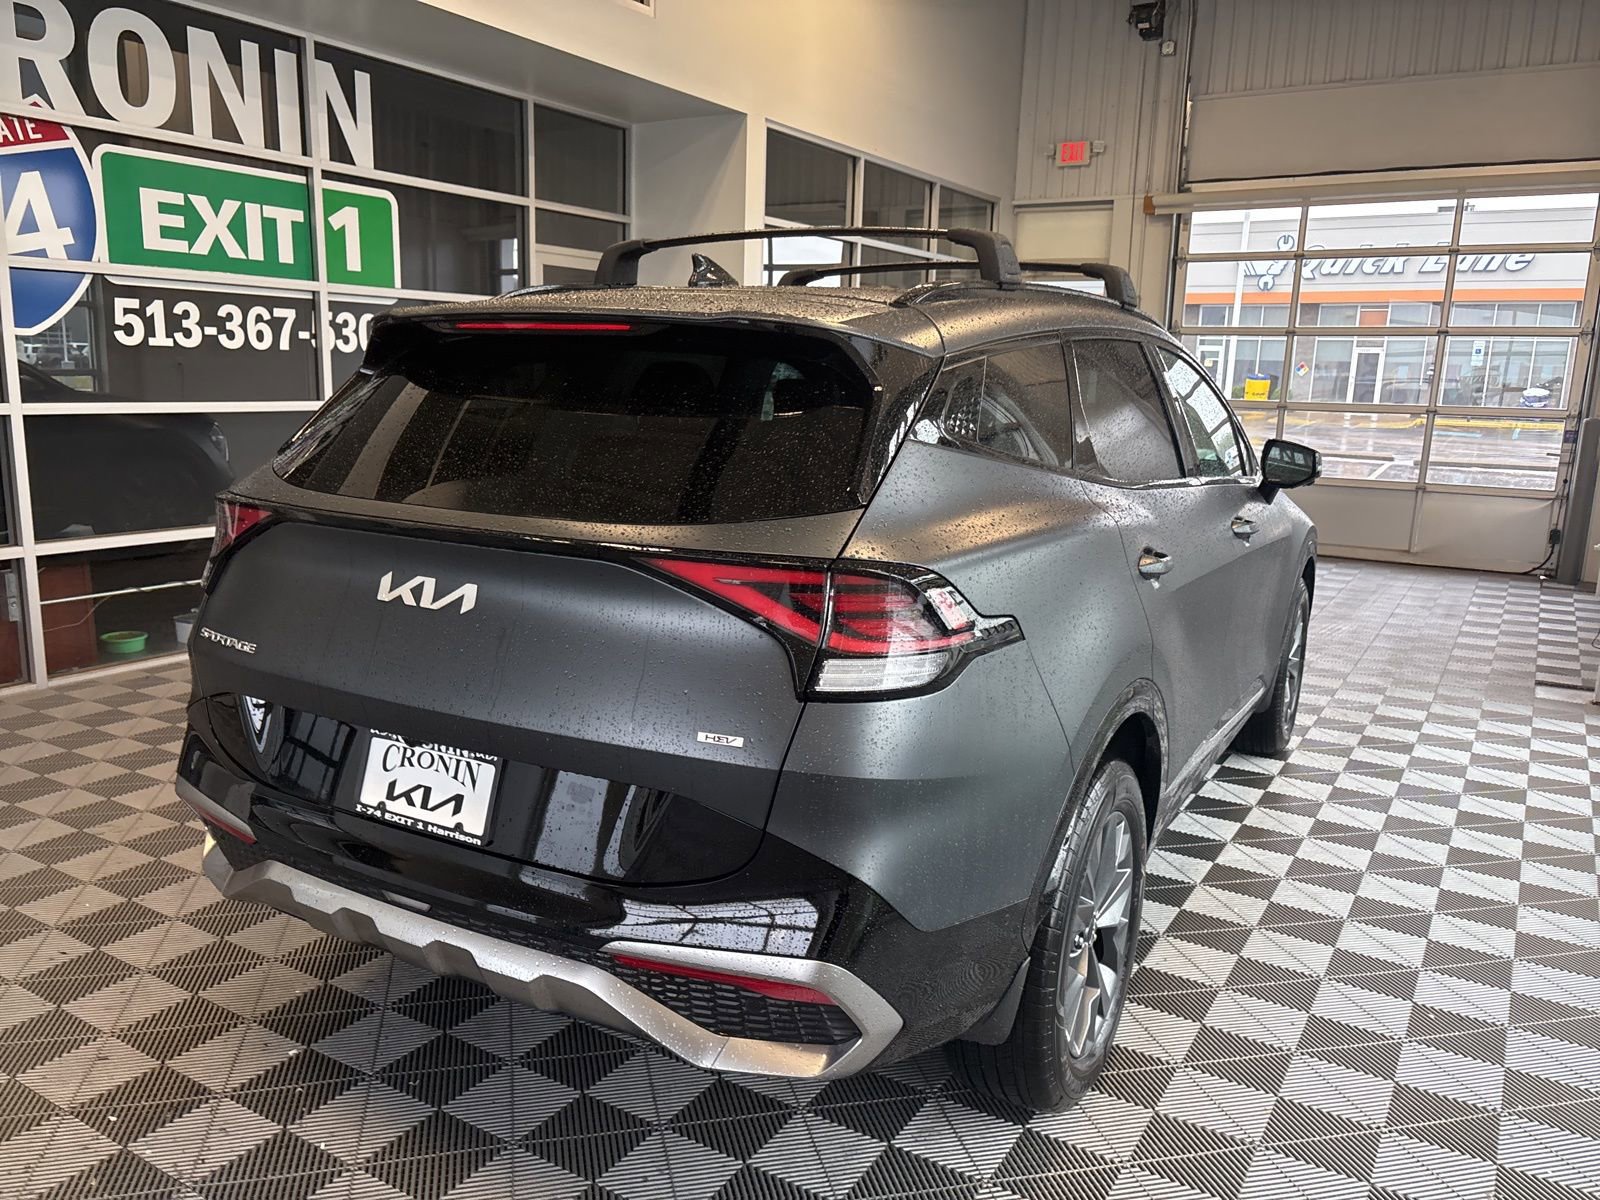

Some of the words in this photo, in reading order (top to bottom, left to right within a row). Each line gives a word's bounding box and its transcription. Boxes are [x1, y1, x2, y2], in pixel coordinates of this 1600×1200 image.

[1060, 141, 1086, 163] EXIT
[139, 187, 305, 264] EXIT
[327, 205, 363, 273] 1
[377, 571, 478, 614] KIA
[200, 626, 258, 654] SPORTAGE
[703, 733, 739, 745] HEV
[382, 743, 482, 793] CRONIN
[385, 777, 466, 817] KIA
[355, 803, 382, 818] I-74
[384, 812, 415, 828] EXIT
[416, 819, 425, 831] 1
[427, 822, 482, 846] Harrison
